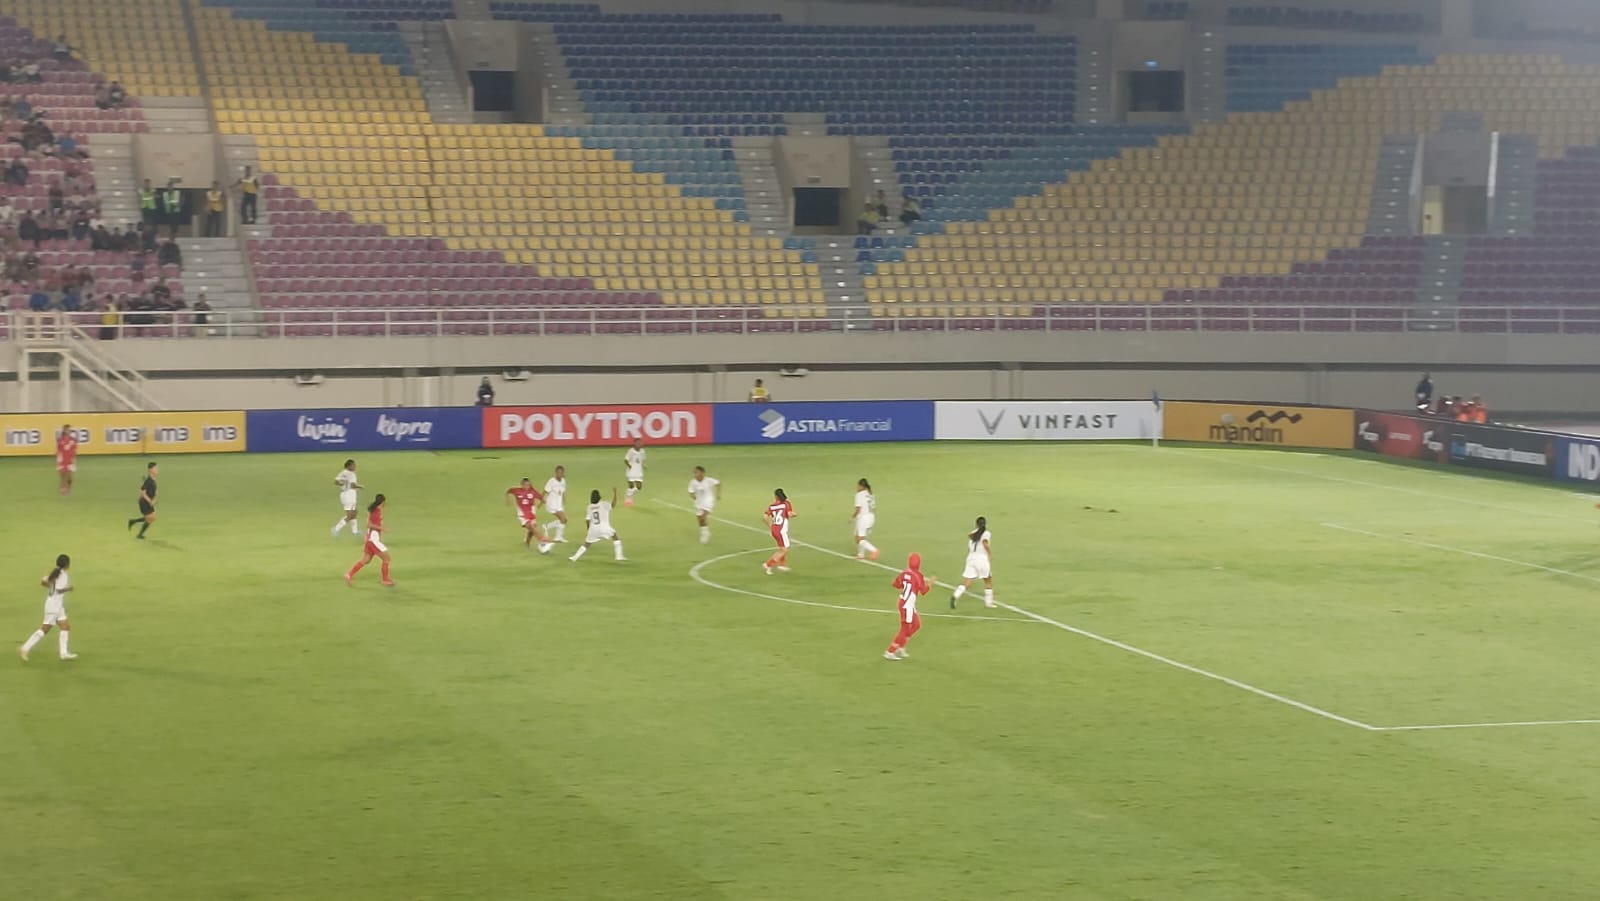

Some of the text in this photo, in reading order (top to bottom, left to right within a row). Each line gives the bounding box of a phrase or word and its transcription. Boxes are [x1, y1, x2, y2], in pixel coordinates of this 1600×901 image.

[499, 410, 697, 441] POLYTRON
[787, 418, 892, 433] ASTRA Financial
[1018, 414, 1118, 429] VINFAST
[5, 429, 41, 445] im3
[105, 428, 141, 443] im3
[154, 427, 190, 442] im3
[203, 425, 238, 441] im3
